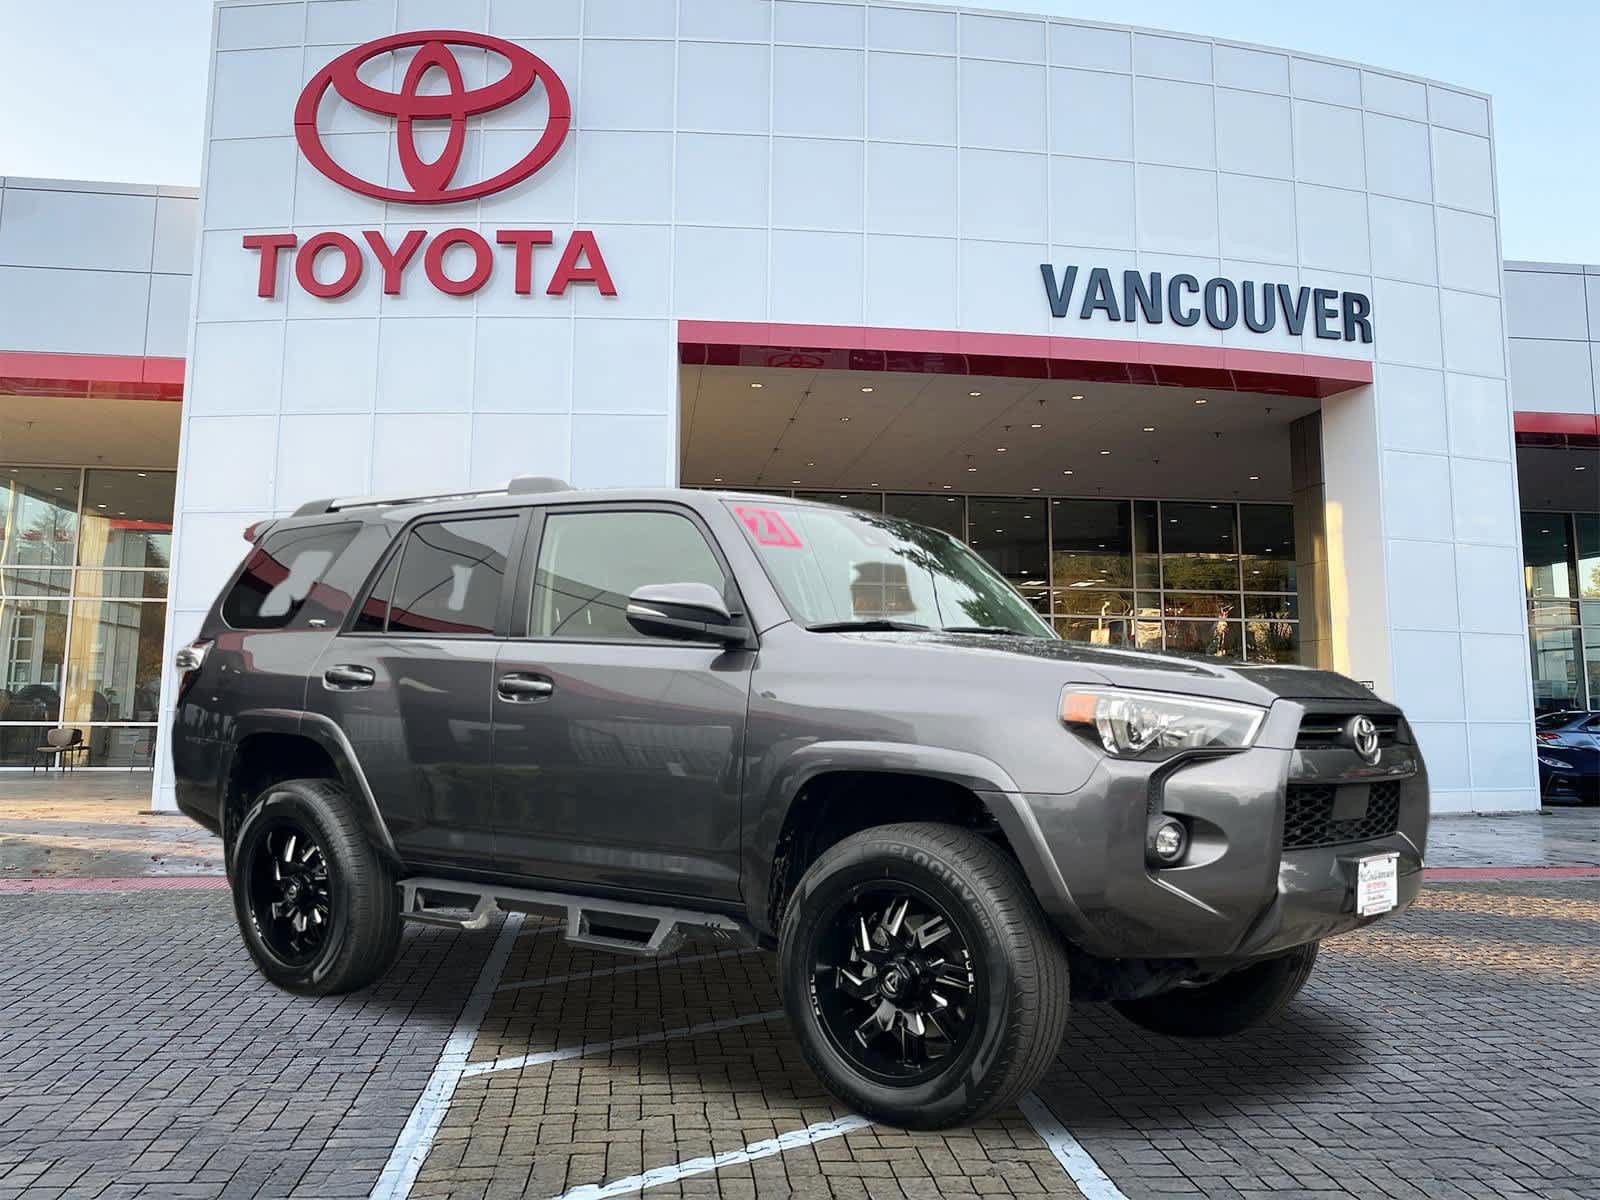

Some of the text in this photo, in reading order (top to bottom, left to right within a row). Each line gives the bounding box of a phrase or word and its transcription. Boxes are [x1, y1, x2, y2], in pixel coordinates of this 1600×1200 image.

[242, 228, 618, 299] TOYOTA
[1040, 264, 1374, 343] VANCOUVER
[961, 949, 975, 994] FUEL
